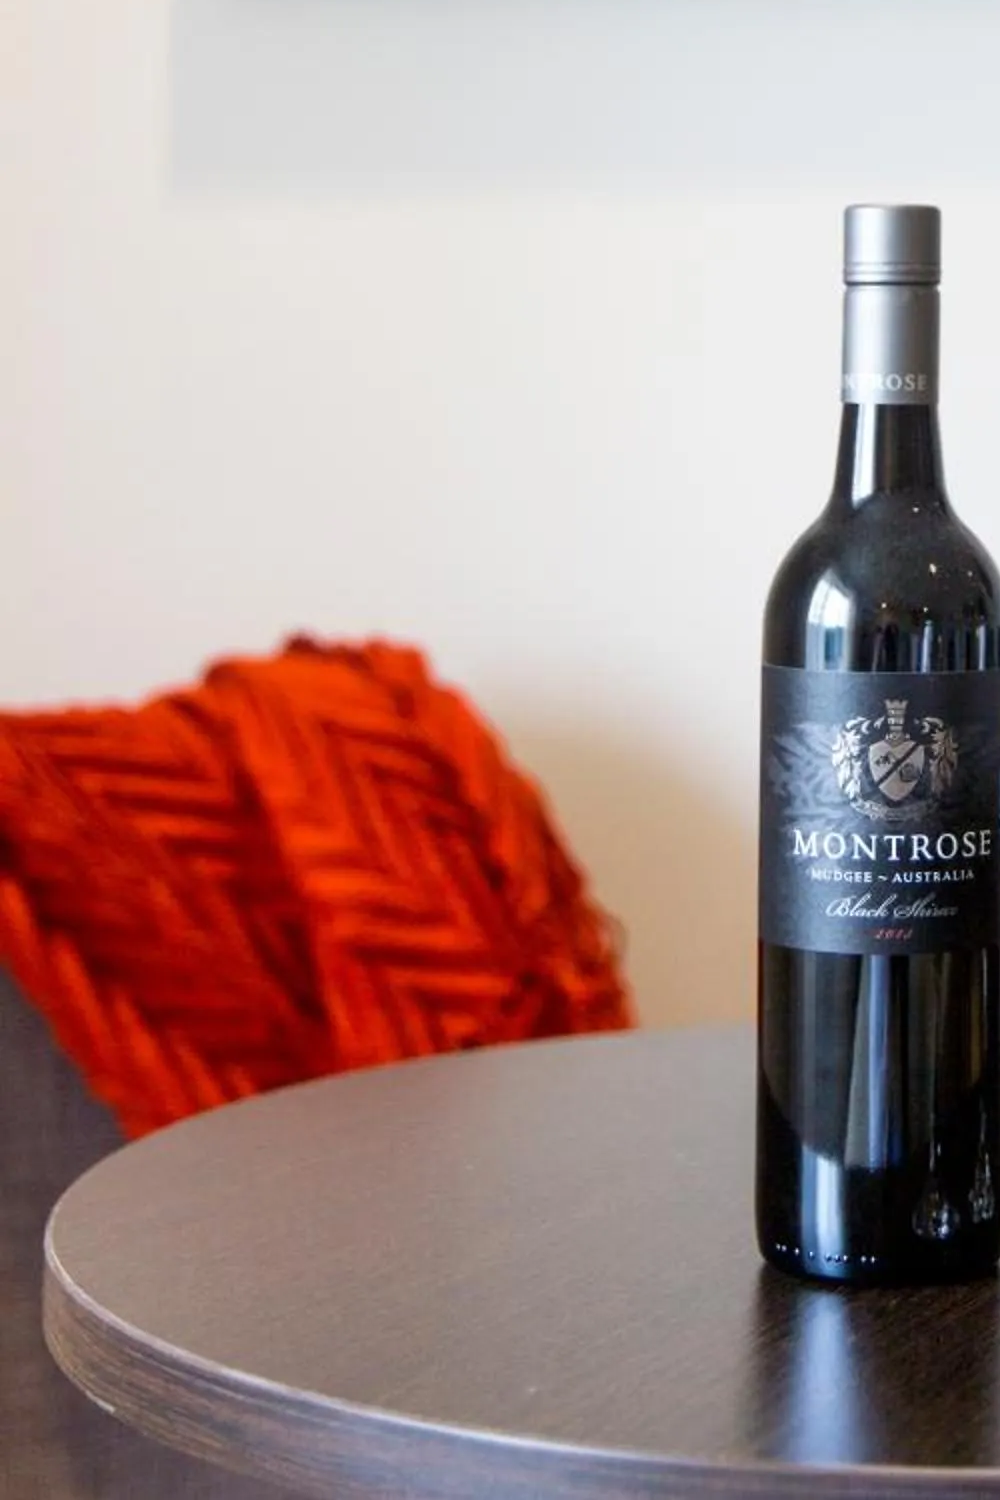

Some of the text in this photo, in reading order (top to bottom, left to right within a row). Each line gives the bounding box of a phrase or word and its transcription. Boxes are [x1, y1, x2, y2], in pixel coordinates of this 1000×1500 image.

[792, 828, 992, 861] MONTROSE
[809, 867, 873, 884] MUDGEE
[891, 869, 975, 884] AUSTRALIA
[824, 892, 959, 918] Black Shiraz
